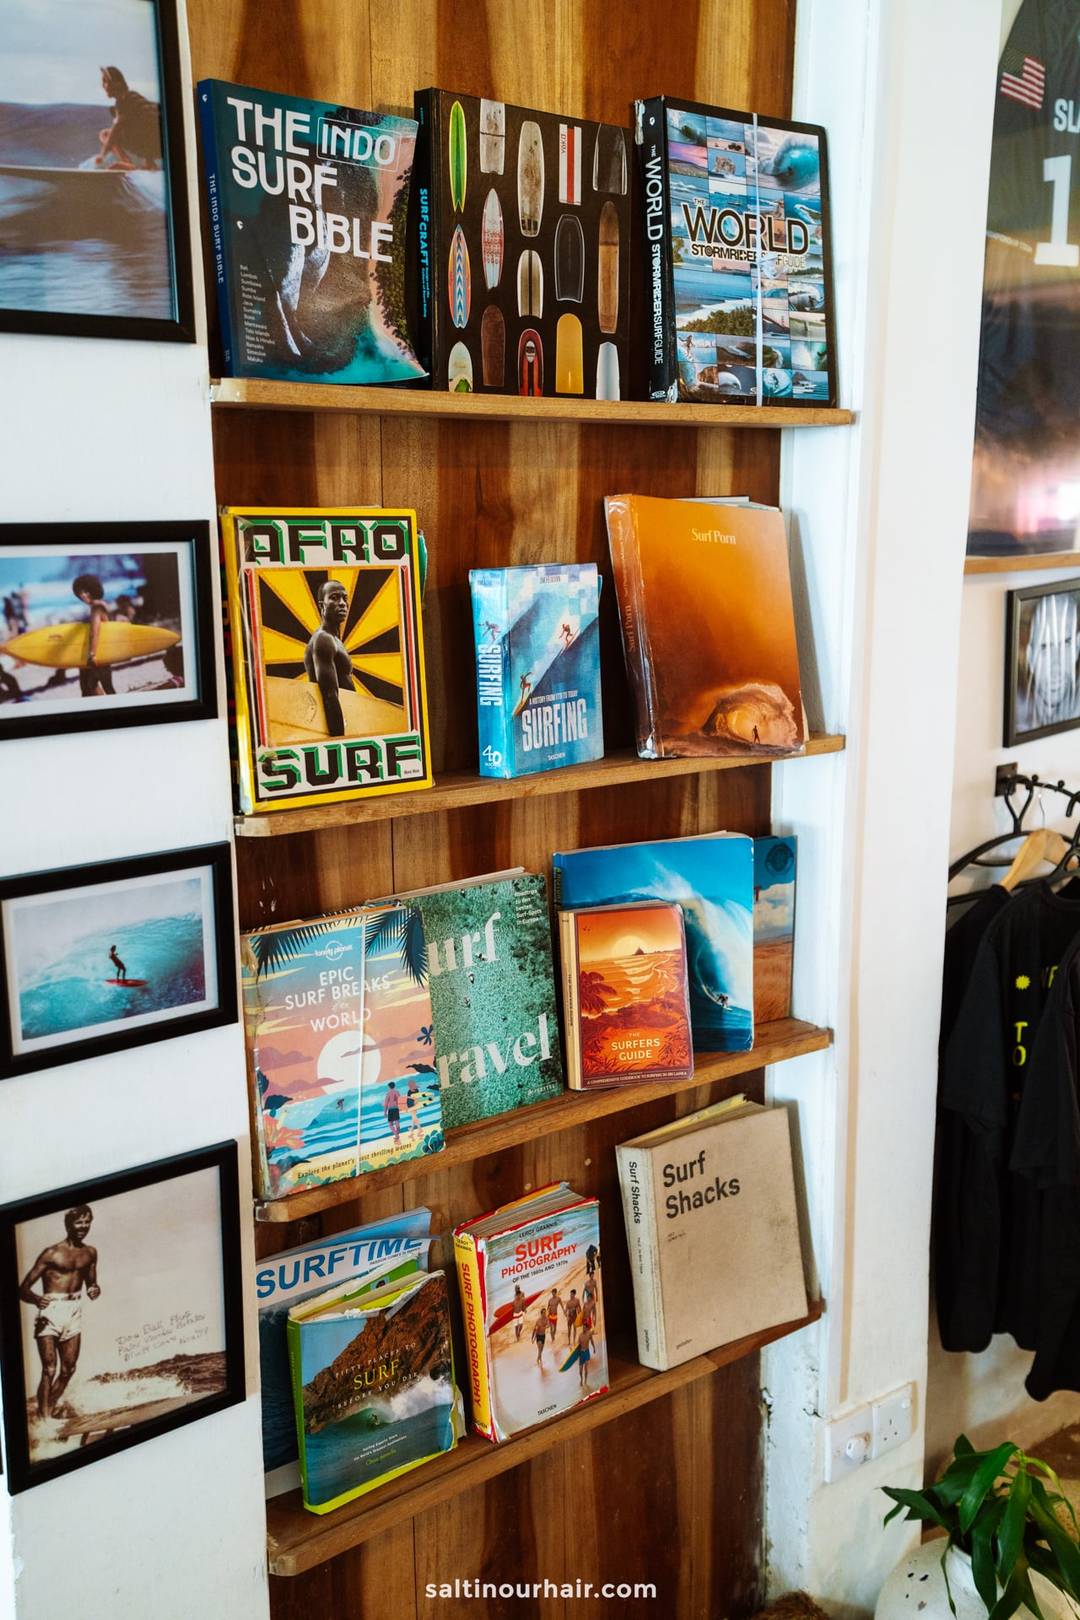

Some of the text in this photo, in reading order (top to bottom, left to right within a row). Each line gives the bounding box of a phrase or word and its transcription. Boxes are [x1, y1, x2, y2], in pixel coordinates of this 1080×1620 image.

[227, 97, 396, 166] THE INDO
[231, 146, 338, 205] SURF
[645, 157, 664, 240] WORLD
[209, 173, 224, 284] THE INDO SURF BIBLE
[289, 204, 394, 263] BIBLE
[419, 188, 429, 266] SURFCRAFT
[682, 203, 809, 256] WORLD
[240, 520, 409, 564] AFRO
[691, 528, 736, 545] Surf Porn
[478, 644, 503, 706] SURFING
[522, 698, 588, 752] SURFING
[259, 735, 421, 791] SURF
[427, 911, 501, 977] urf
[285, 988, 325, 1011] SURF
[331, 975, 391, 1000] BREAKS
[319, 966, 354, 986] EPIC
[310, 1008, 372, 1032] WORLD
[436, 1012, 553, 1090] ravel
[611, 1038, 661, 1051] SURFERS
[619, 1049, 653, 1061] GUIDE
[663, 1150, 706, 1188] Surf
[629, 1161, 641, 1224] Surf Shacks
[665, 1176, 741, 1219] Shacks
[501, 1244, 577, 1279] PHOTOGRAPHY
[515, 1231, 564, 1262] SURF
[544, 1264, 555, 1272] AND
[461, 1263, 473, 1299] SURF
[353, 1359, 400, 1391] SURF
[466, 1302, 482, 1407] PHOTOGRAPHY
[378, 1381, 396, 1391] YOU
